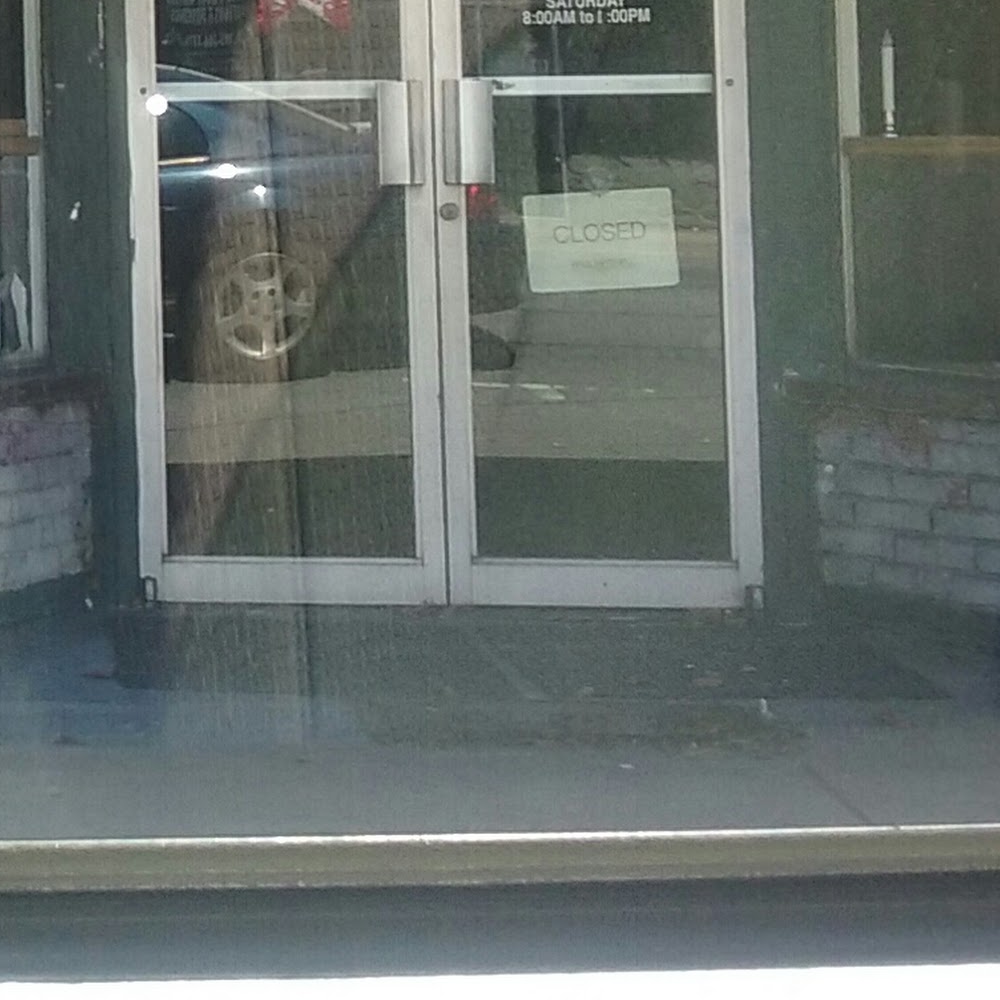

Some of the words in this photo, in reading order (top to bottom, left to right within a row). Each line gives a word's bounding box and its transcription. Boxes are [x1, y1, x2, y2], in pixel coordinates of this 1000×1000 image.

[522, 10, 576, 25] 8:00AM
[579, 11, 594, 24] to
[553, 220, 647, 244] CLOSED
